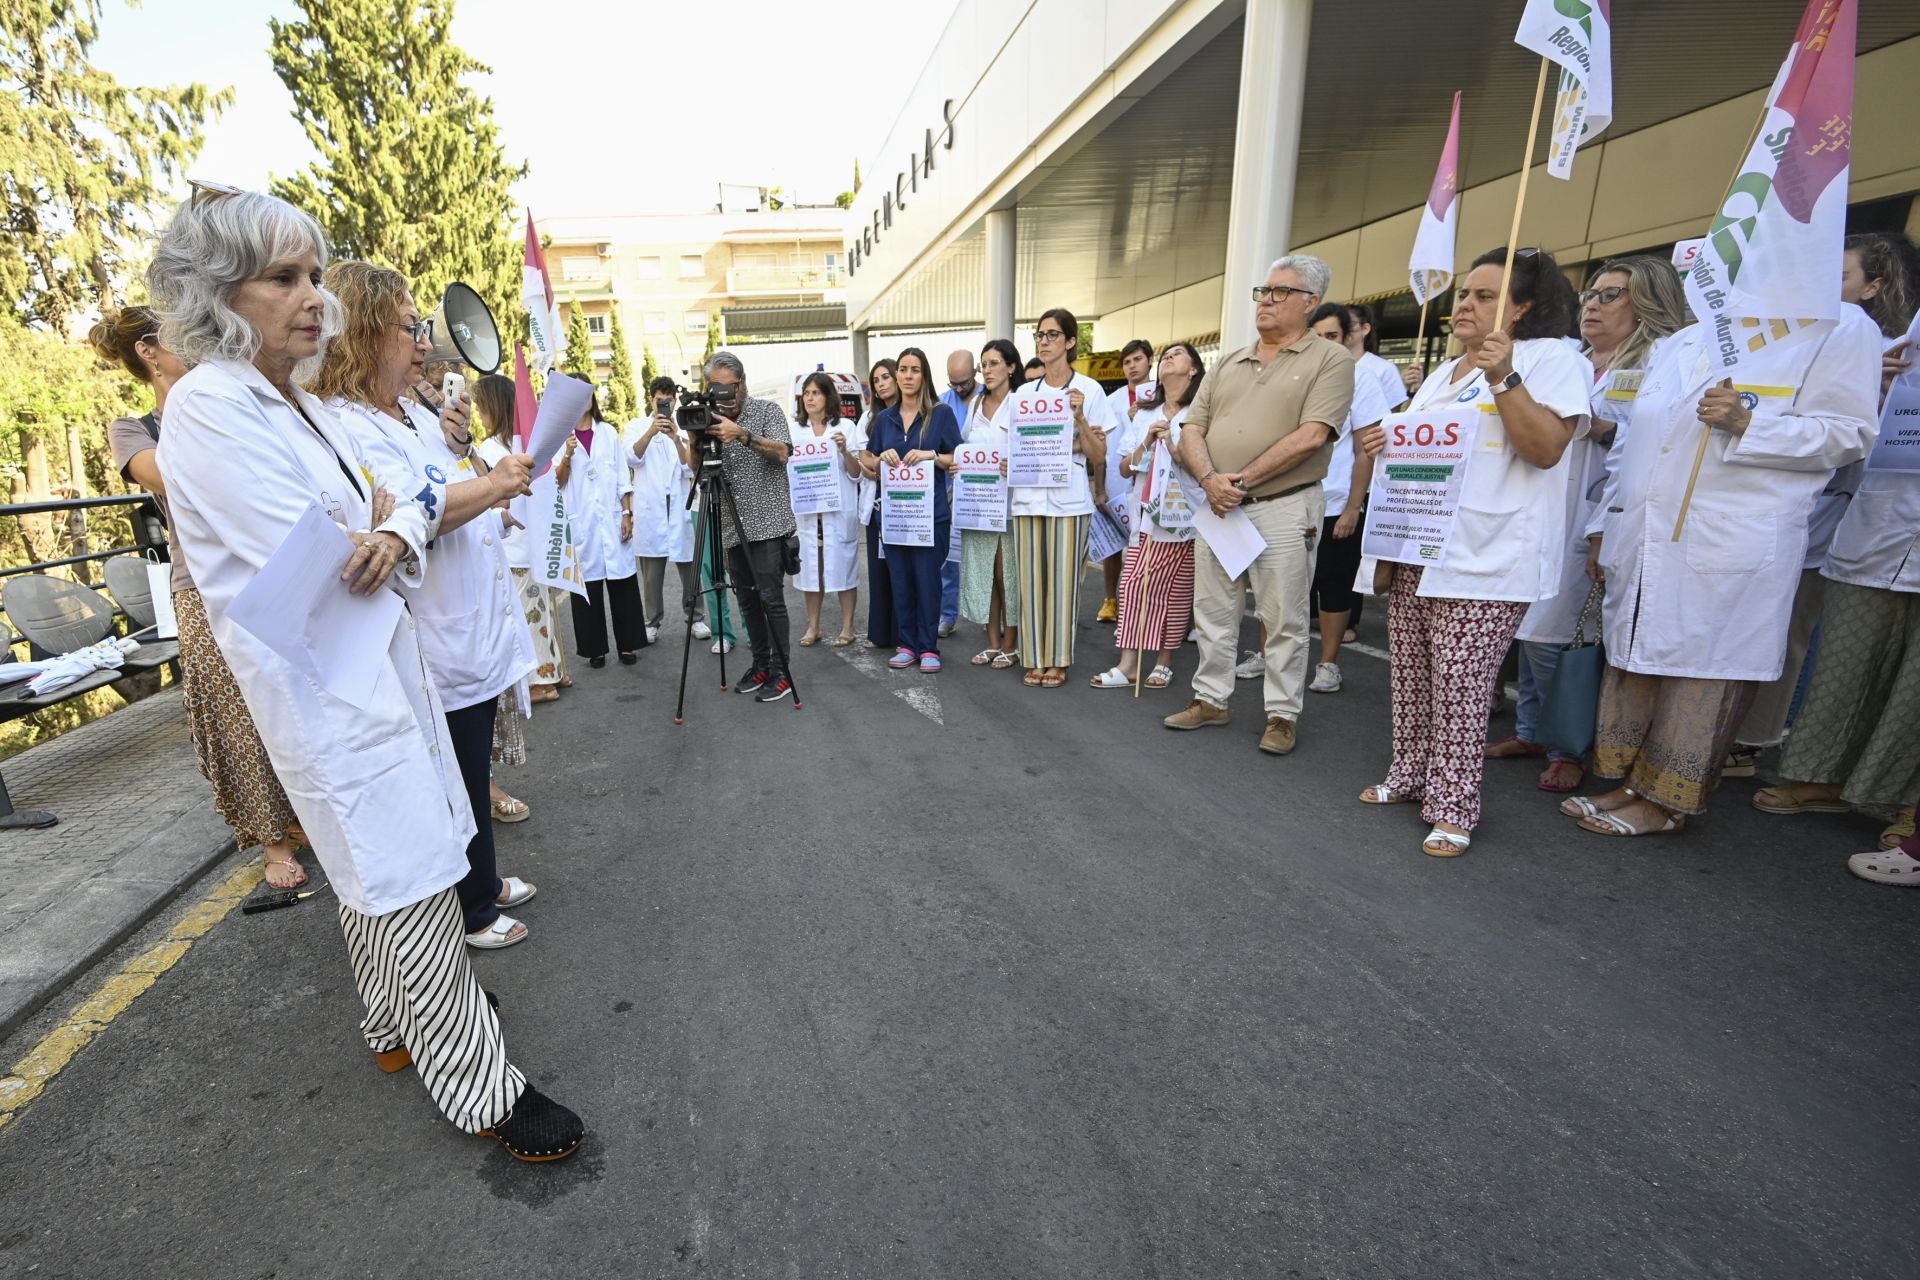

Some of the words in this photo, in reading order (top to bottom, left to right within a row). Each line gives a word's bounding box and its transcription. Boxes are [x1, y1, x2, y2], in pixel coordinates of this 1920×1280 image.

[1703, 289, 1726, 310] de
[1714, 313, 1740, 367] Murcia
[1019, 398, 1064, 415] S.O.S
[1393, 422, 1459, 447] S.O.S
[794, 442, 828, 457] S.O.S
[1382, 452, 1415, 460] URGENCIAS
[1416, 452, 1463, 460] HOSPITALARIAS
[962, 450, 999, 464] S.O.S
[889, 467, 924, 481] S.O.S
[1386, 487, 1437, 496] CONCENTRACIÓN
[1386, 497, 1433, 506] PROFESIONALES
[1373, 505, 1406, 514] URGENCIAS
[1406, 508, 1453, 517] HOSPITALARIAS
[1369, 530, 1393, 538] HOSPITAL
